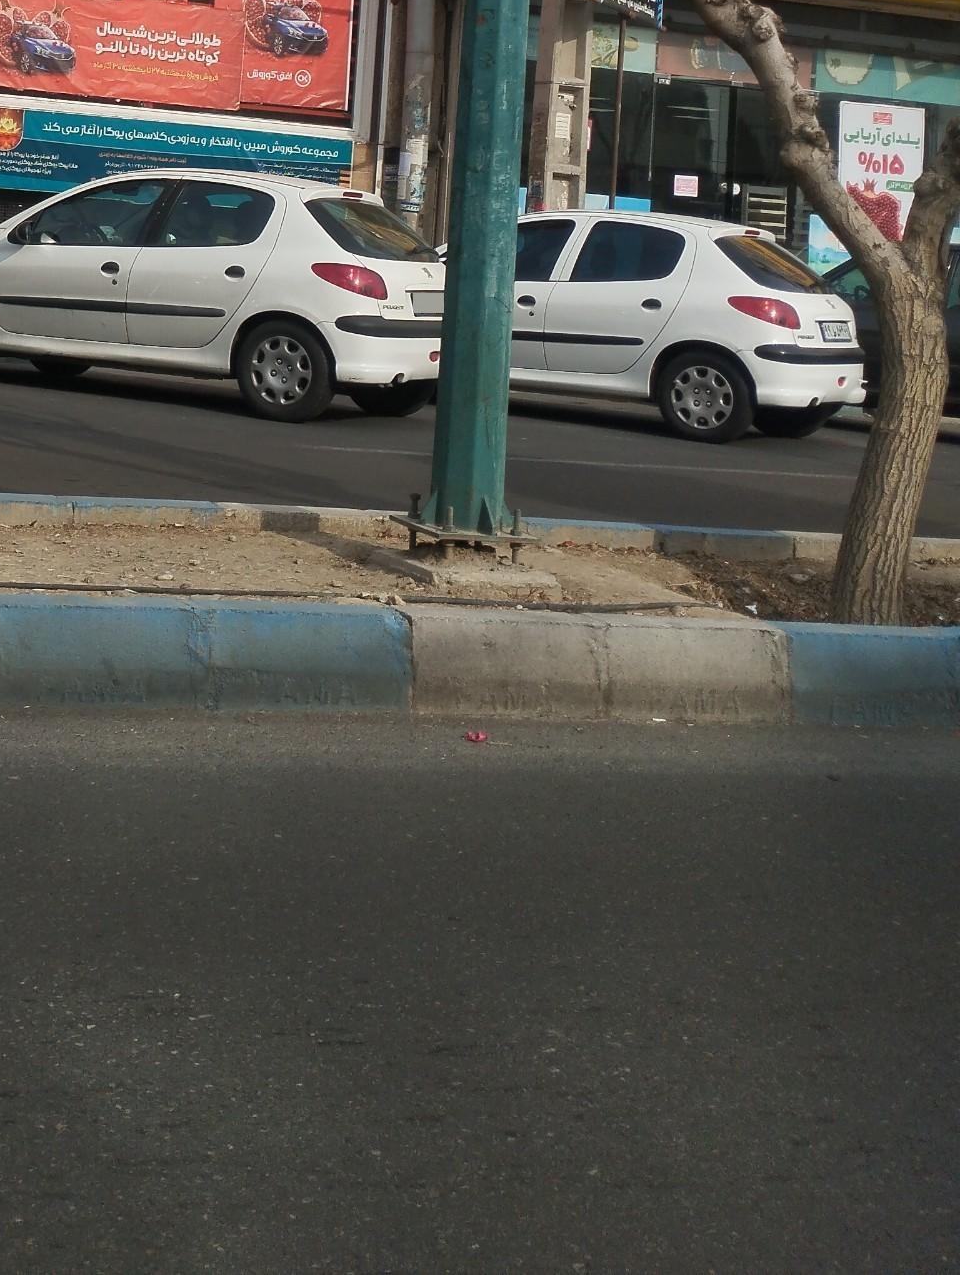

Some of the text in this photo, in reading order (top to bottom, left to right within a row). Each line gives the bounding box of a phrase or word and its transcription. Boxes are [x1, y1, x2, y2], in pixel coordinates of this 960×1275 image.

[96, 21, 222, 49] طولانی ترین شب سال
[95, 40, 220, 67] کوتاه ترین راه تا بالنو
[246, 69, 293, 82] افق کوروش
[42, 122, 61, 132] کند
[61, 126, 80, 136] می
[81, 124, 97, 136] آغاز
[97, 127, 103, 138] را
[103, 126, 125, 139] یوگا
[125, 129, 168, 142] کلاسهای
[168, 132, 190, 145] زودی
[843, 127, 921, 150] یلدای آریایی
[190, 138, 202, 147] به
[208, 136, 234, 148] افتخار
[234, 140, 242, 149] با
[243, 141, 266, 153] مبین
[267, 140, 301, 154] کوروش
[302, 148, 339, 160] مجموعه
